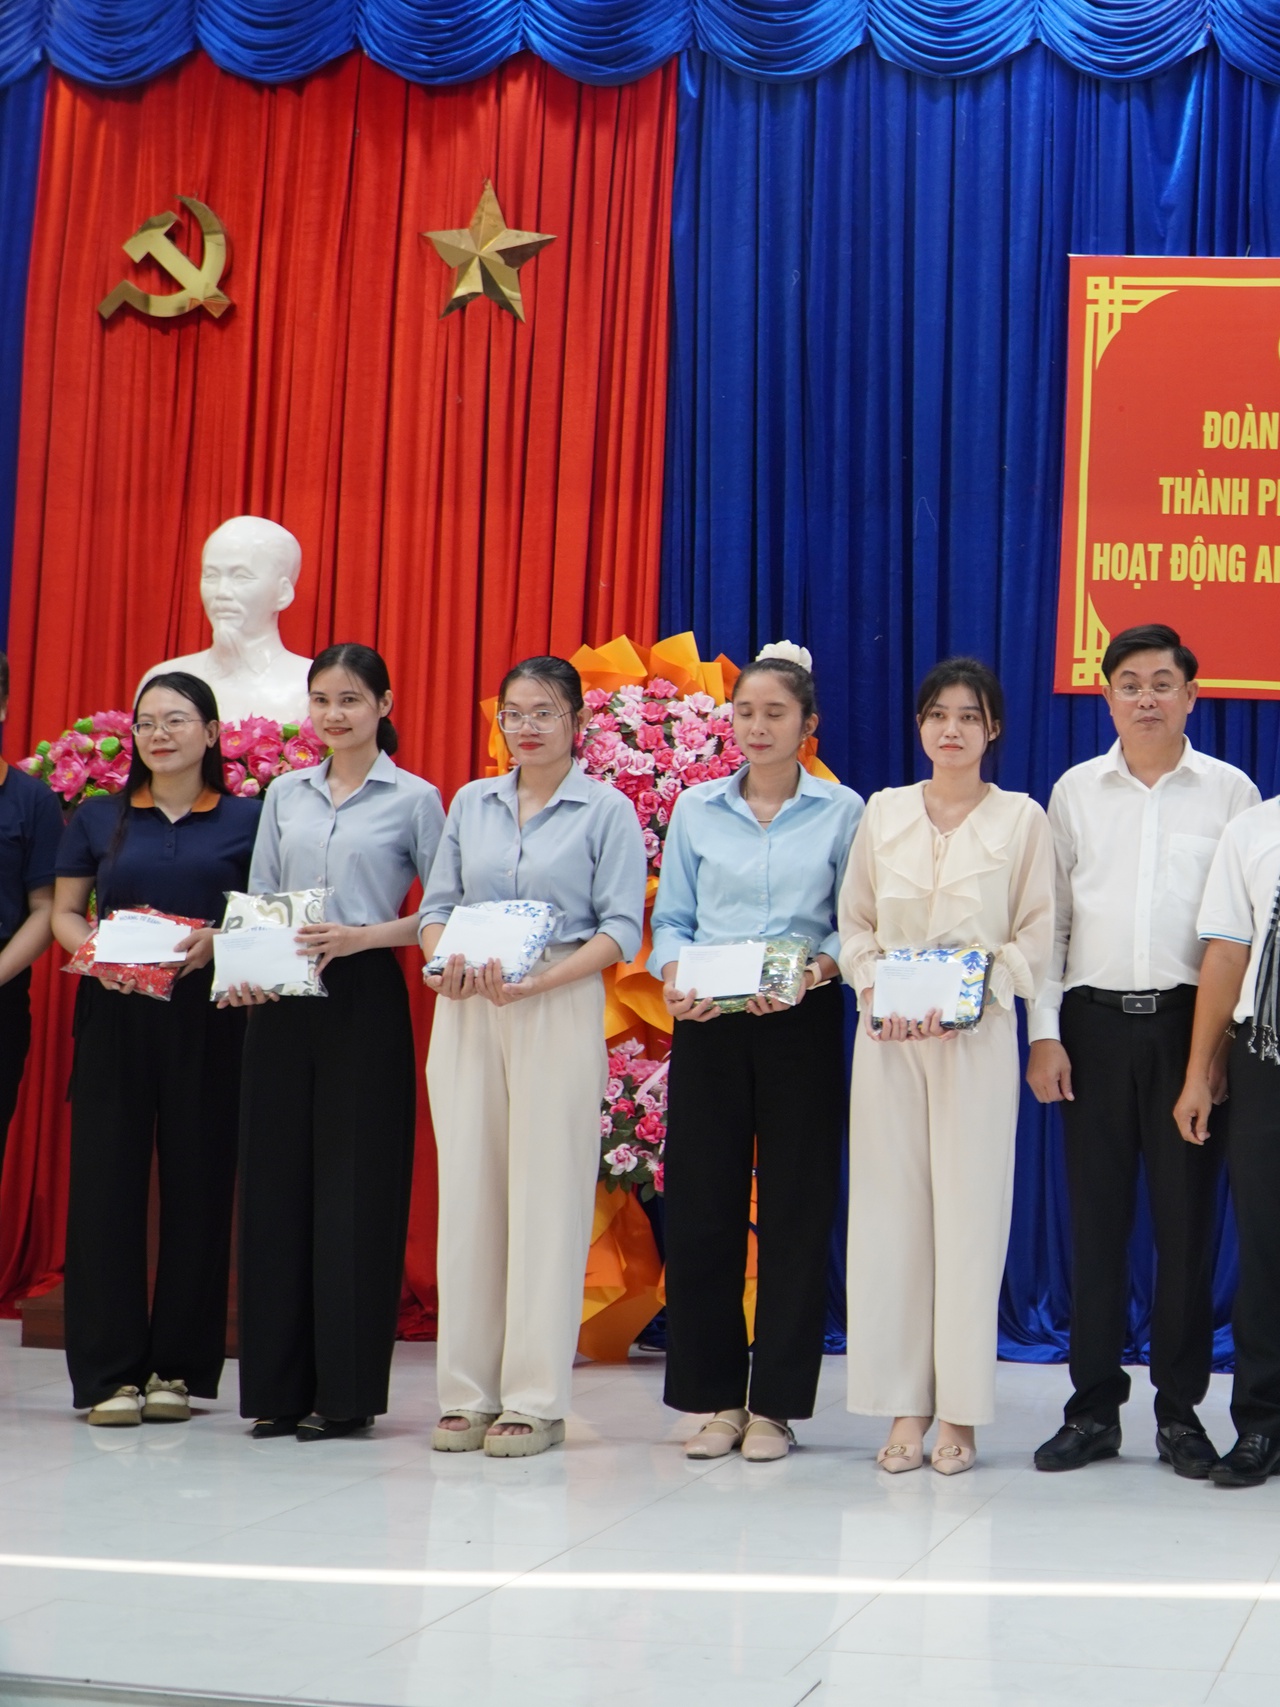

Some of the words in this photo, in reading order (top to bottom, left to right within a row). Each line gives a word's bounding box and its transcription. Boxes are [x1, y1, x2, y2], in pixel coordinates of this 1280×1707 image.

[1202, 403, 1279, 449] ĐOÀN
[1159, 468, 1249, 515] THÀNH
[1093, 542, 1163, 590] HOẠT
[1170, 535, 1246, 591] ĐỘNG
